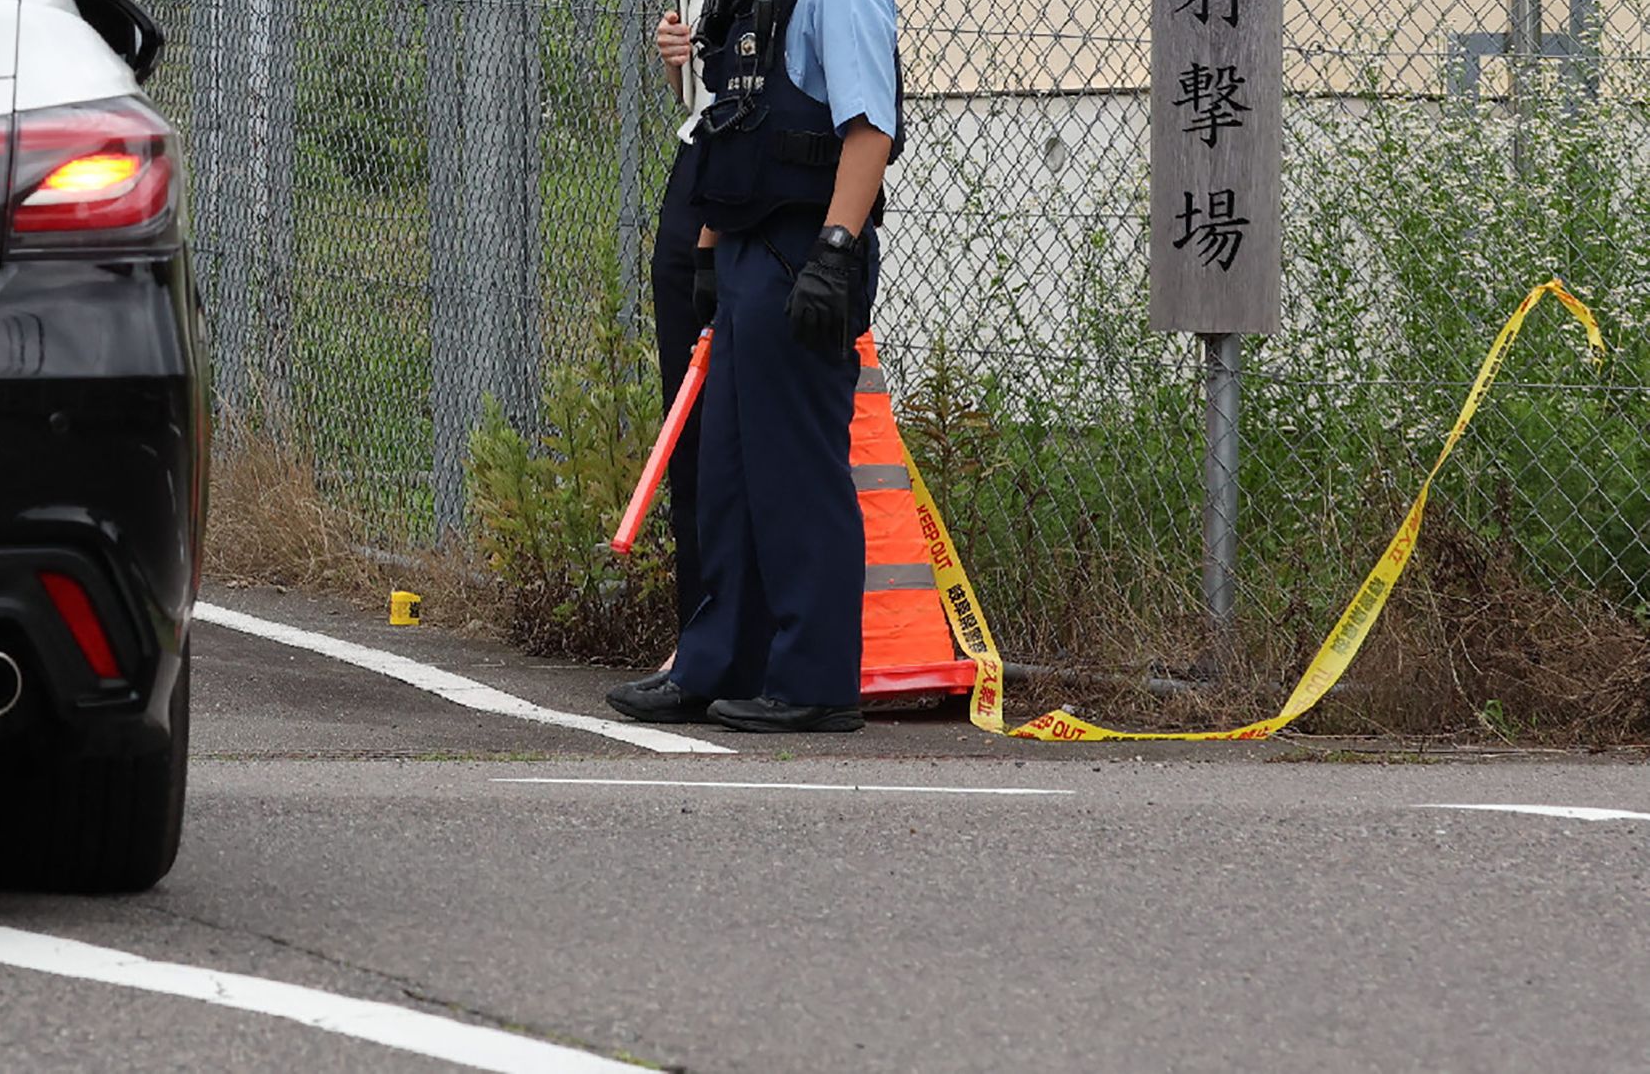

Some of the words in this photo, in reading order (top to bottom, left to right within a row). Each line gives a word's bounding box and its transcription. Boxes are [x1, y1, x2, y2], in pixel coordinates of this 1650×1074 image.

[916, 504, 941, 548] KEEP
[930, 542, 954, 571] OUT
[1052, 720, 1087, 741] OUT
